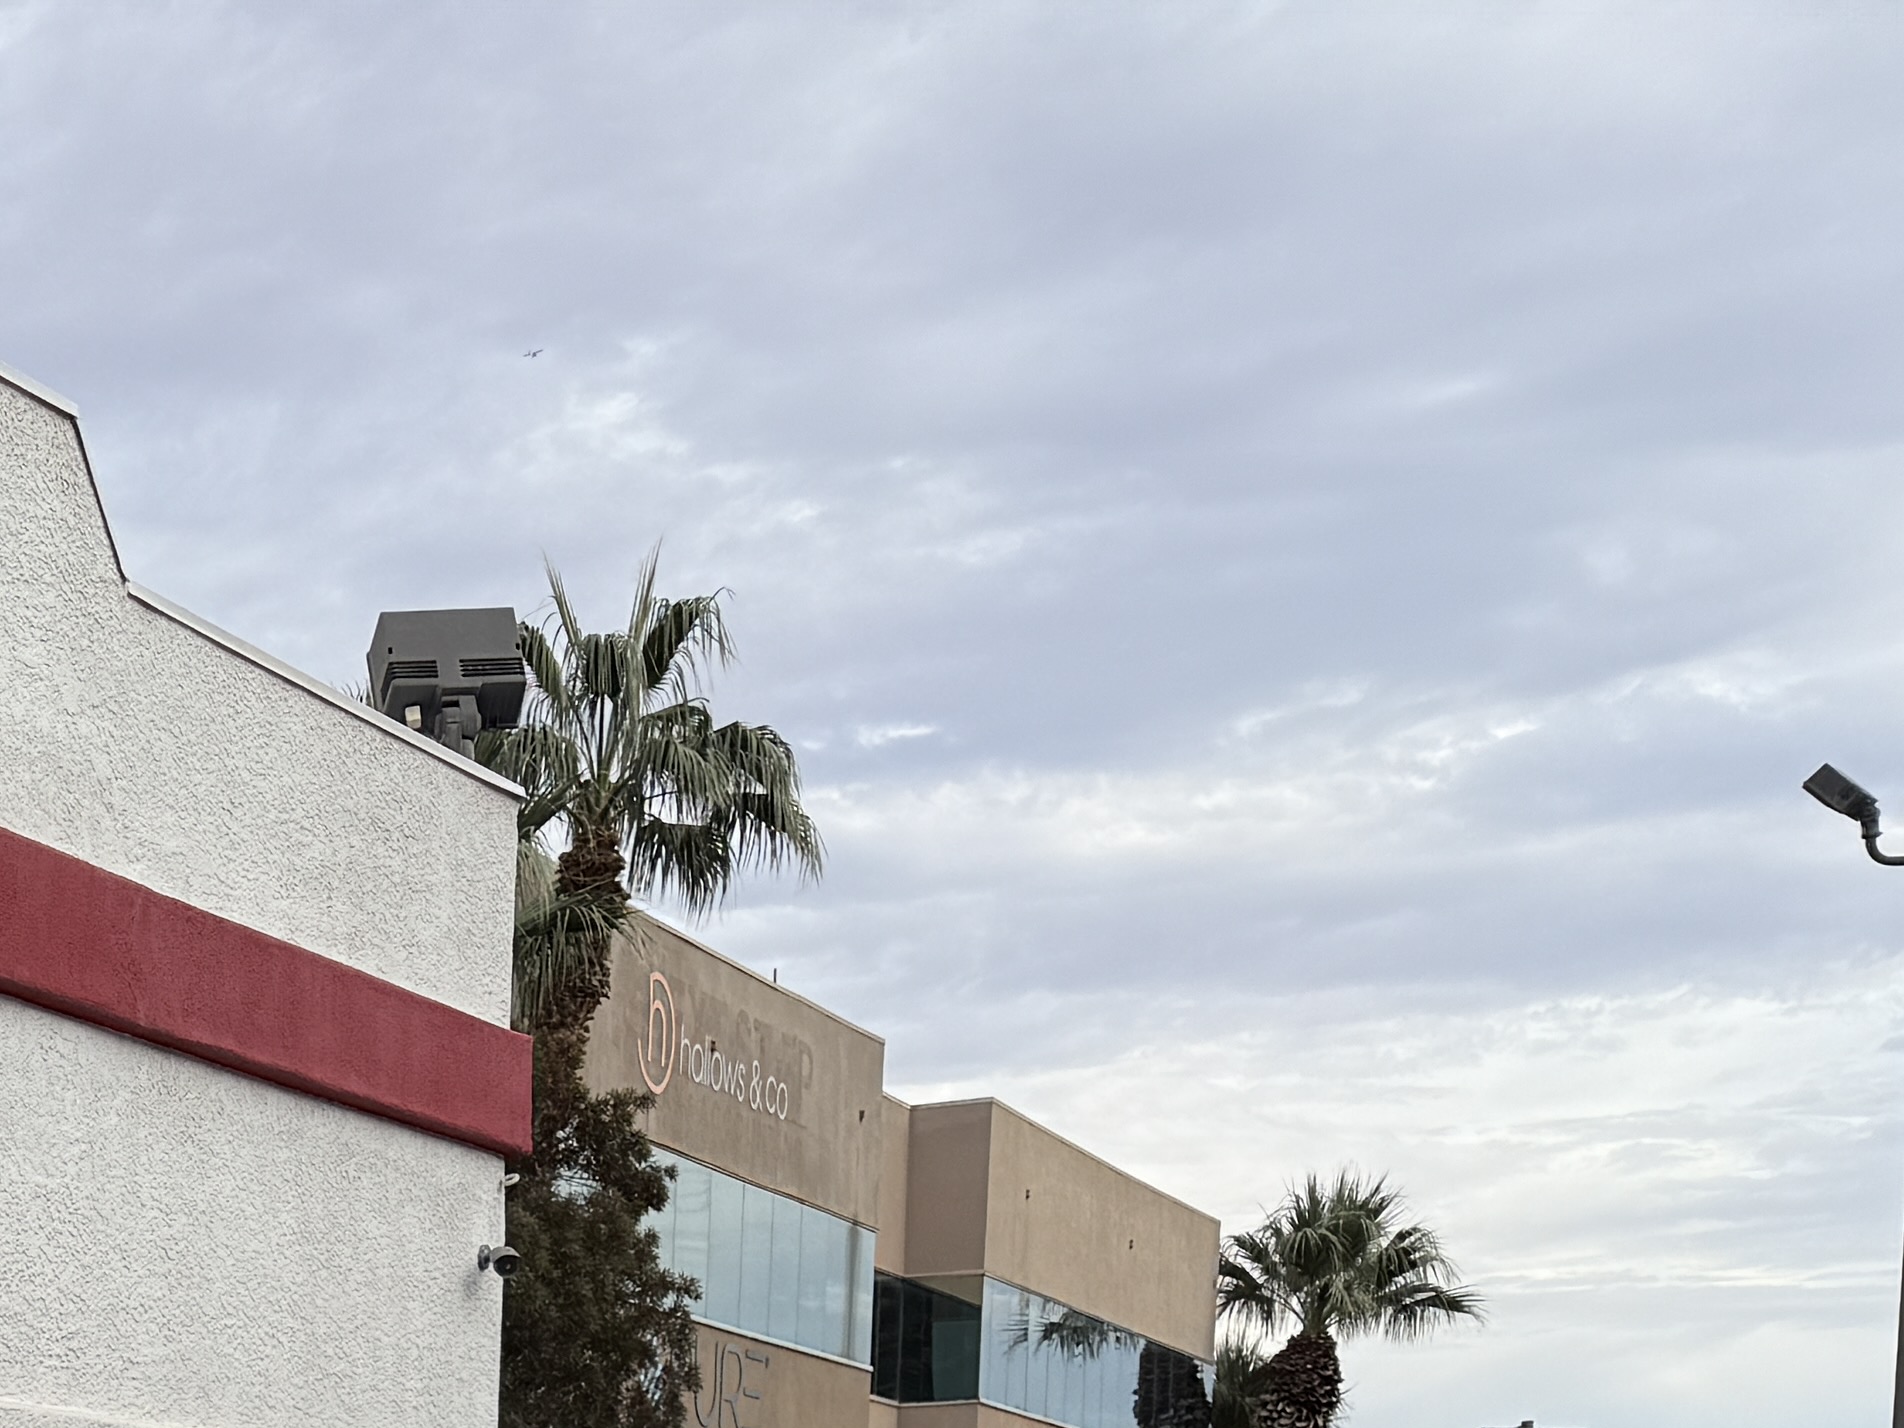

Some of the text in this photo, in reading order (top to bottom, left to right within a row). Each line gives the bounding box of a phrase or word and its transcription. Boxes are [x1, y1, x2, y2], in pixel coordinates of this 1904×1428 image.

[679, 1023, 746, 1102] hallows
[749, 1060, 764, 1112] &
[765, 1075, 788, 1120] co
